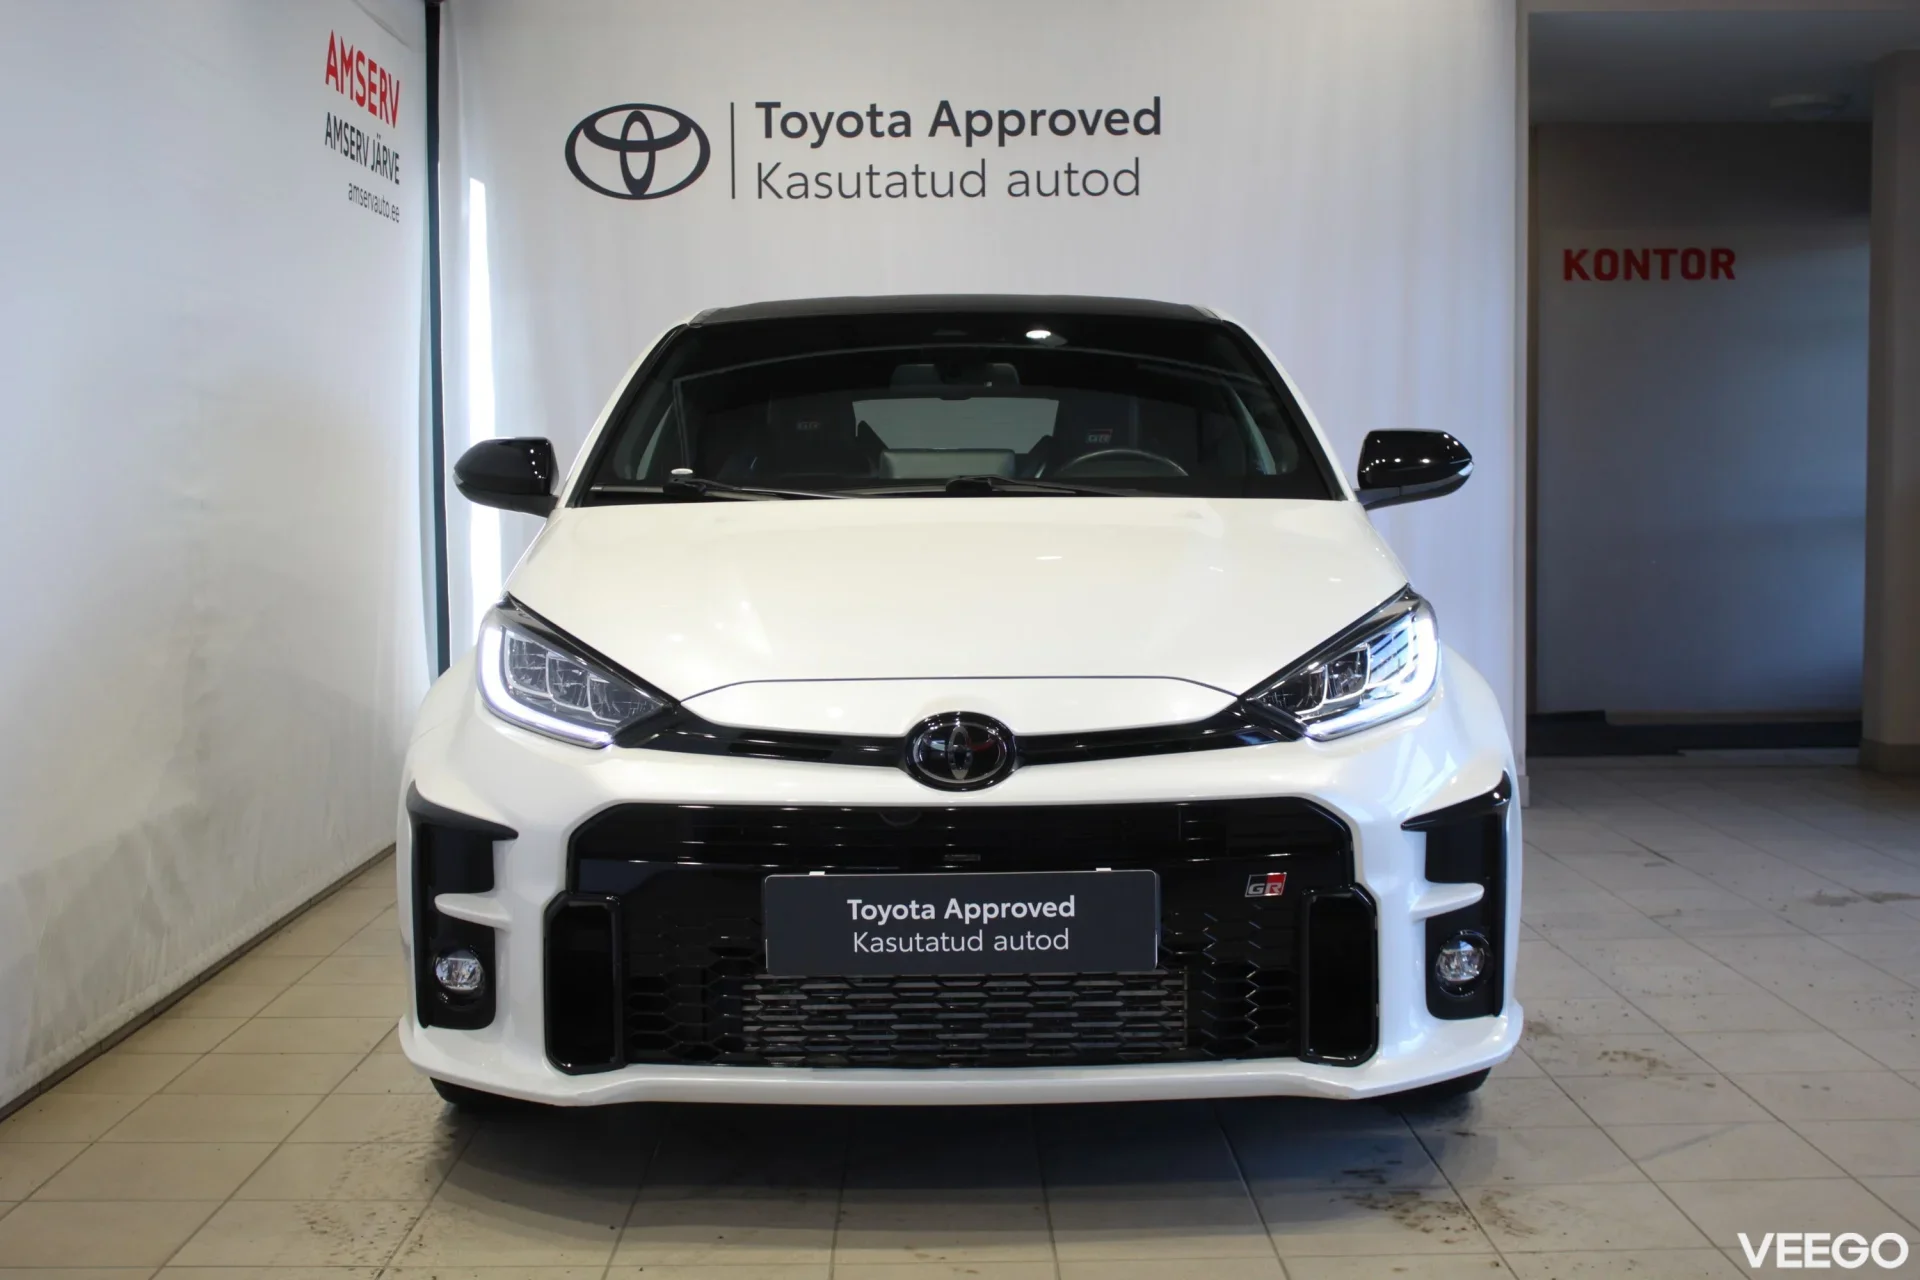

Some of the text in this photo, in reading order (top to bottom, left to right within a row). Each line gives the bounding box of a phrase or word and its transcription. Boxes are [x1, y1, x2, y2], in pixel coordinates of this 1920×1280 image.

[325, 29, 400, 129] AMSERV
[755, 96, 1162, 148] Toyota Approved
[324, 111, 400, 185] AMSERV JÄRVE
[755, 157, 1141, 200] Kasutatud autod
[347, 181, 400, 223] amservauto.ee
[1562, 247, 1736, 281] KONTOR
[1247, 882, 1283, 895] GR
[846, 895, 1075, 925] Toyota Approved
[853, 928, 1070, 953] Kasutatud autod
